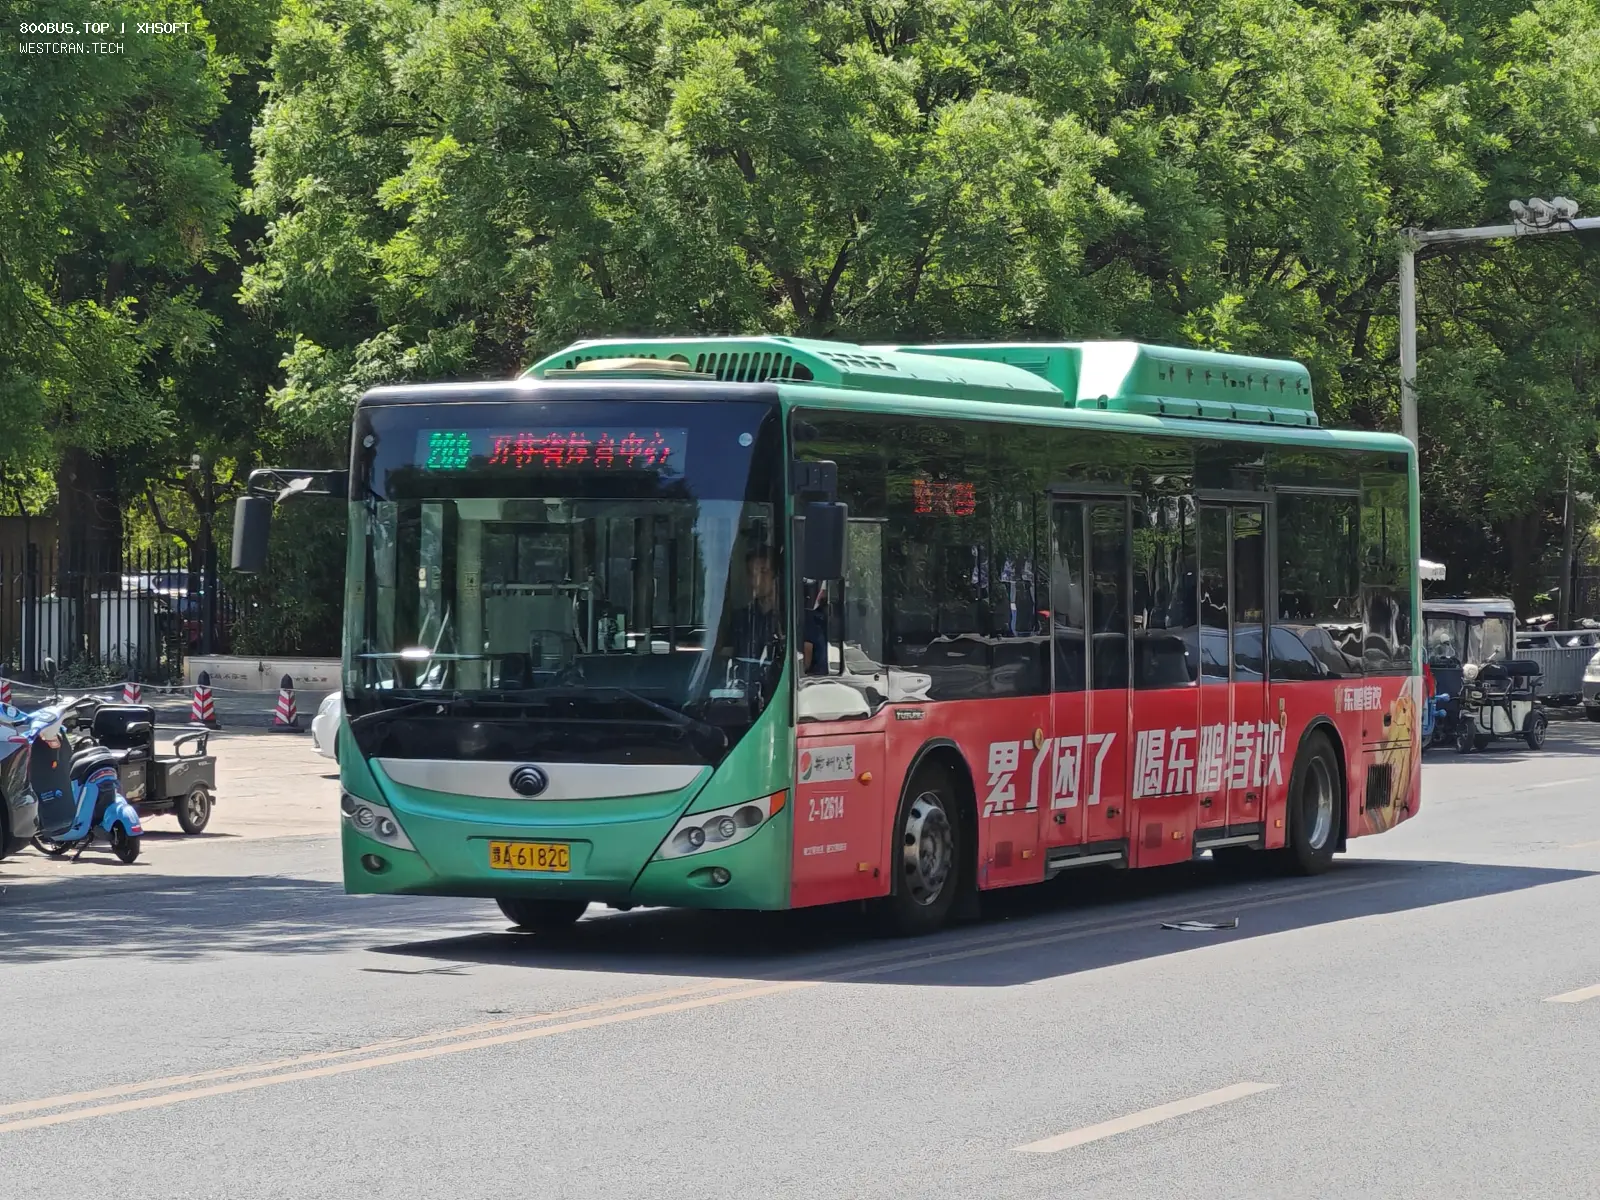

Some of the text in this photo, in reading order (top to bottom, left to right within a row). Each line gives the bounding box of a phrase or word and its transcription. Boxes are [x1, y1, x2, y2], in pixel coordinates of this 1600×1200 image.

[983, 718, 1287, 818] 累了困了 喝东鹏特饮
